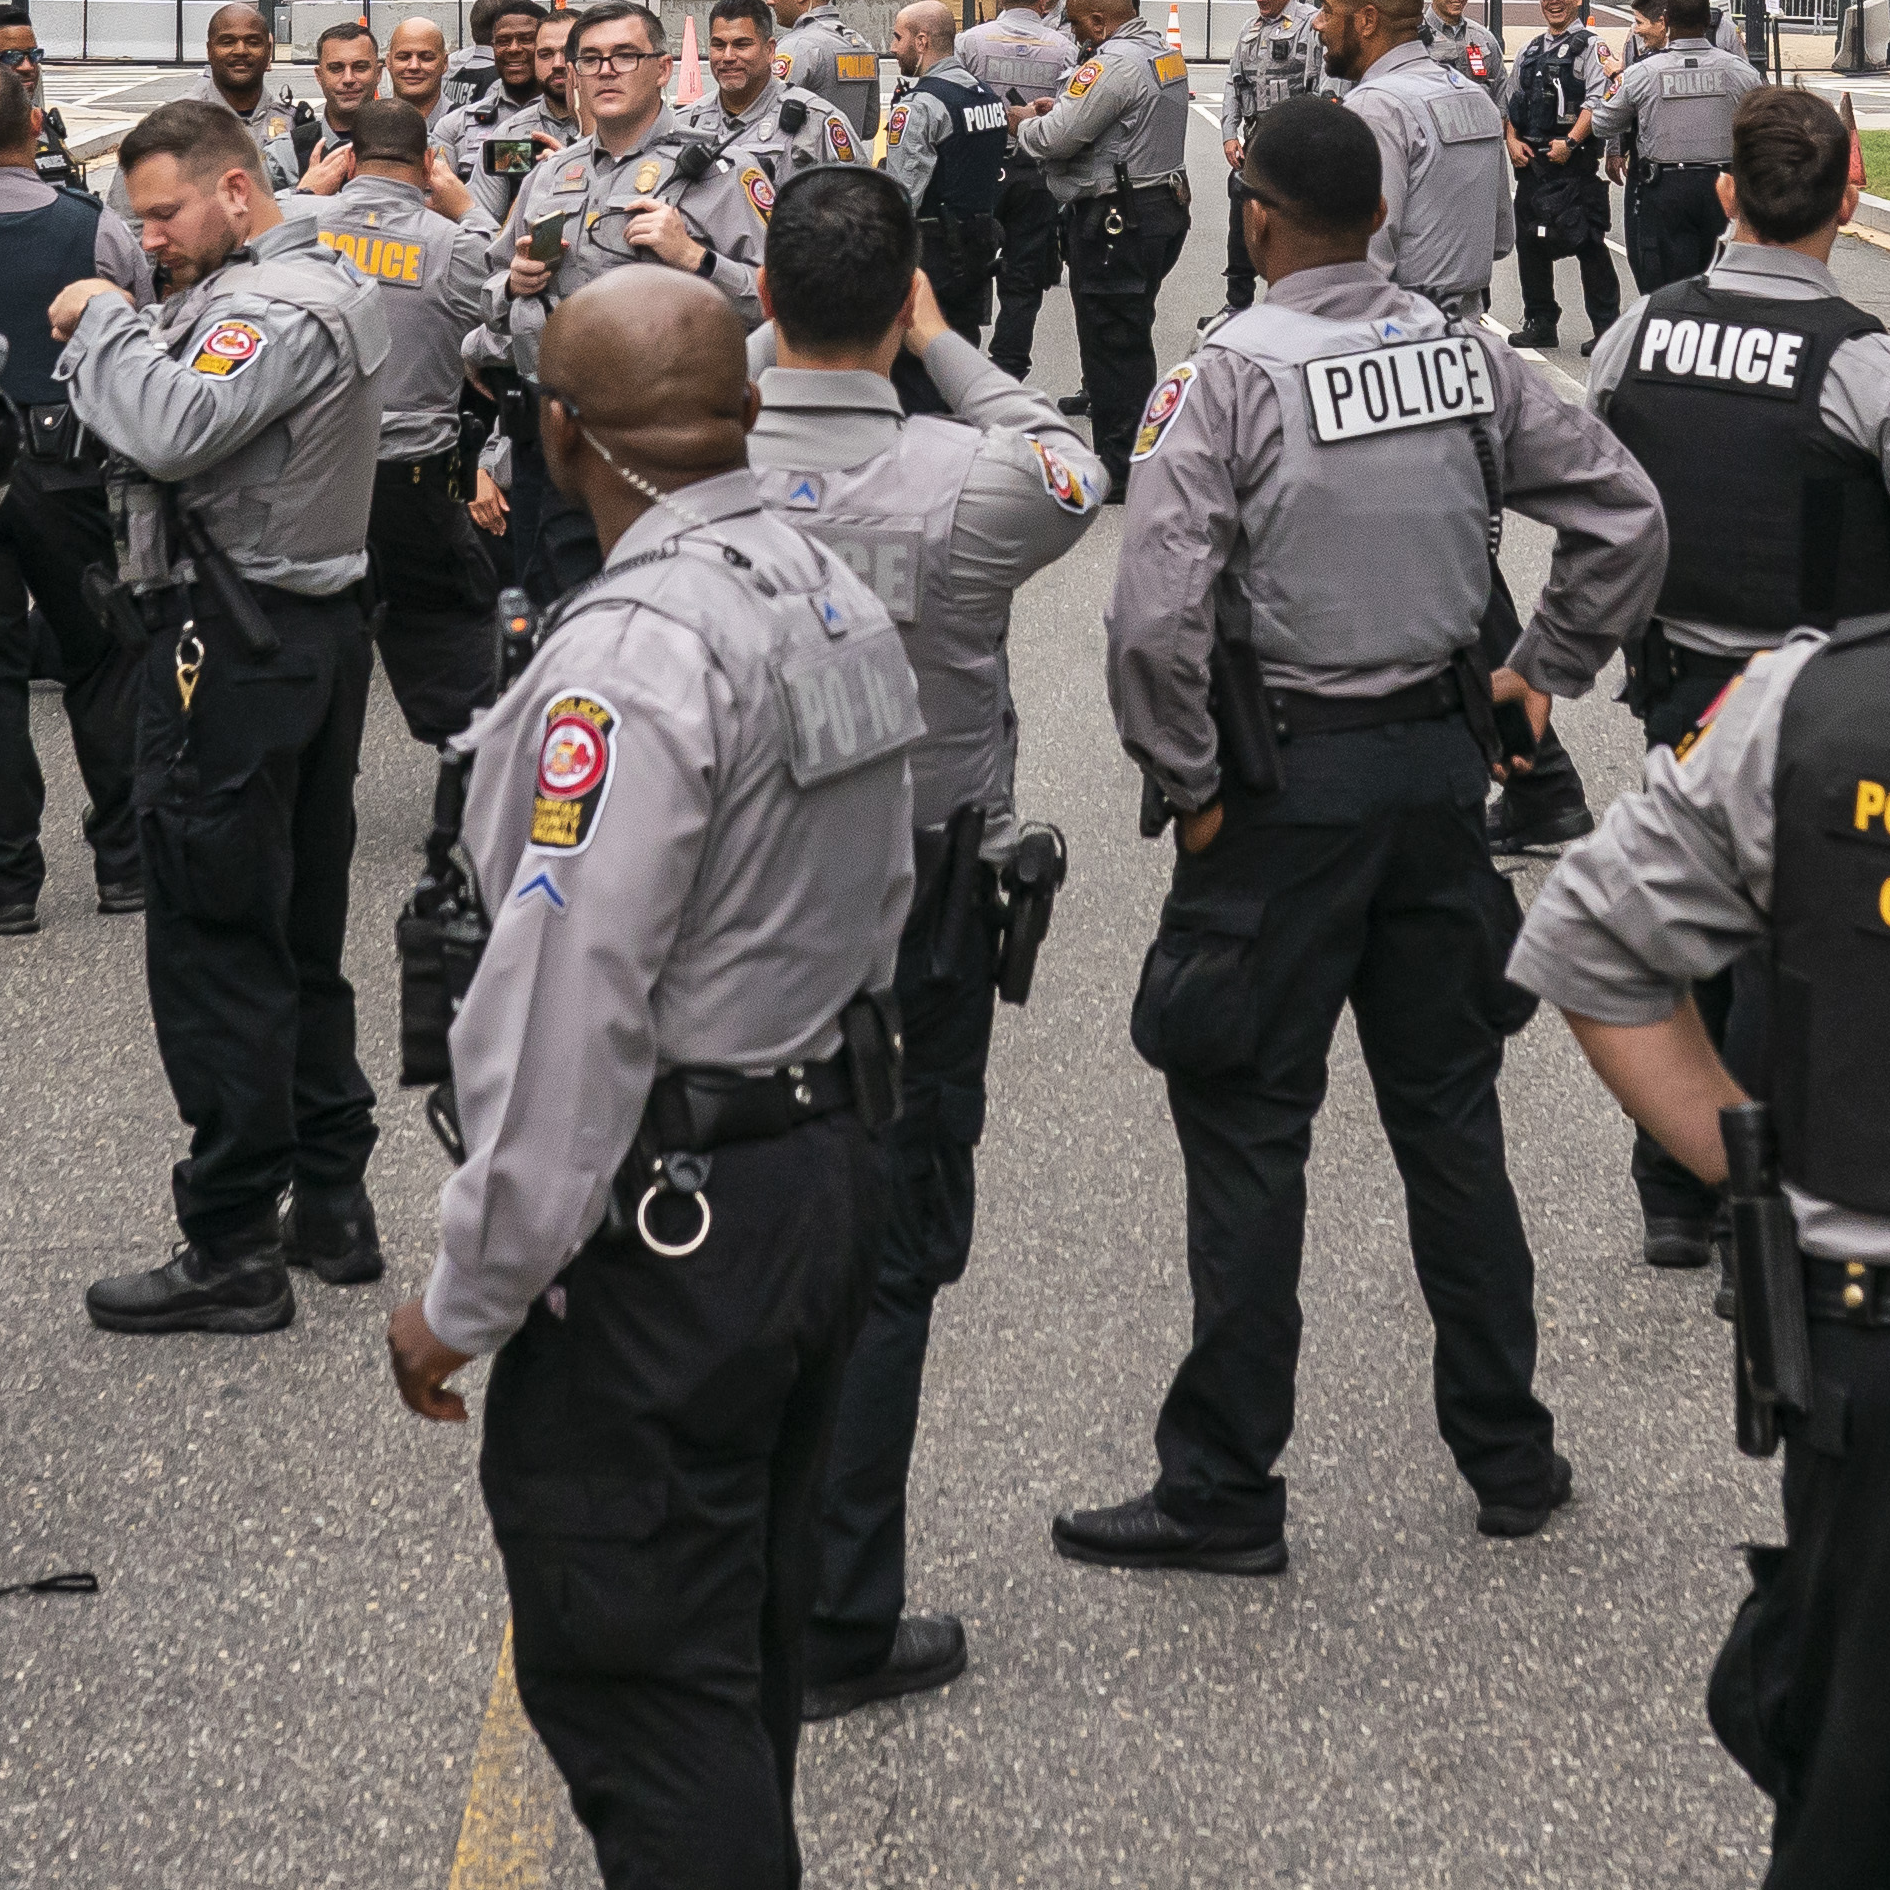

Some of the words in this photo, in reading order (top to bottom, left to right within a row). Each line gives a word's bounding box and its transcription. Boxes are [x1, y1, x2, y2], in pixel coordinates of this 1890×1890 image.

[837, 55, 877, 79] POLICE
[1663, 72, 1723, 95] POLICE
[963, 102, 1007, 133] POLICE
[318, 231, 421, 281] POLICE
[1639, 318, 1804, 389] POLICE
[1326, 345, 1485, 430] POLICE
